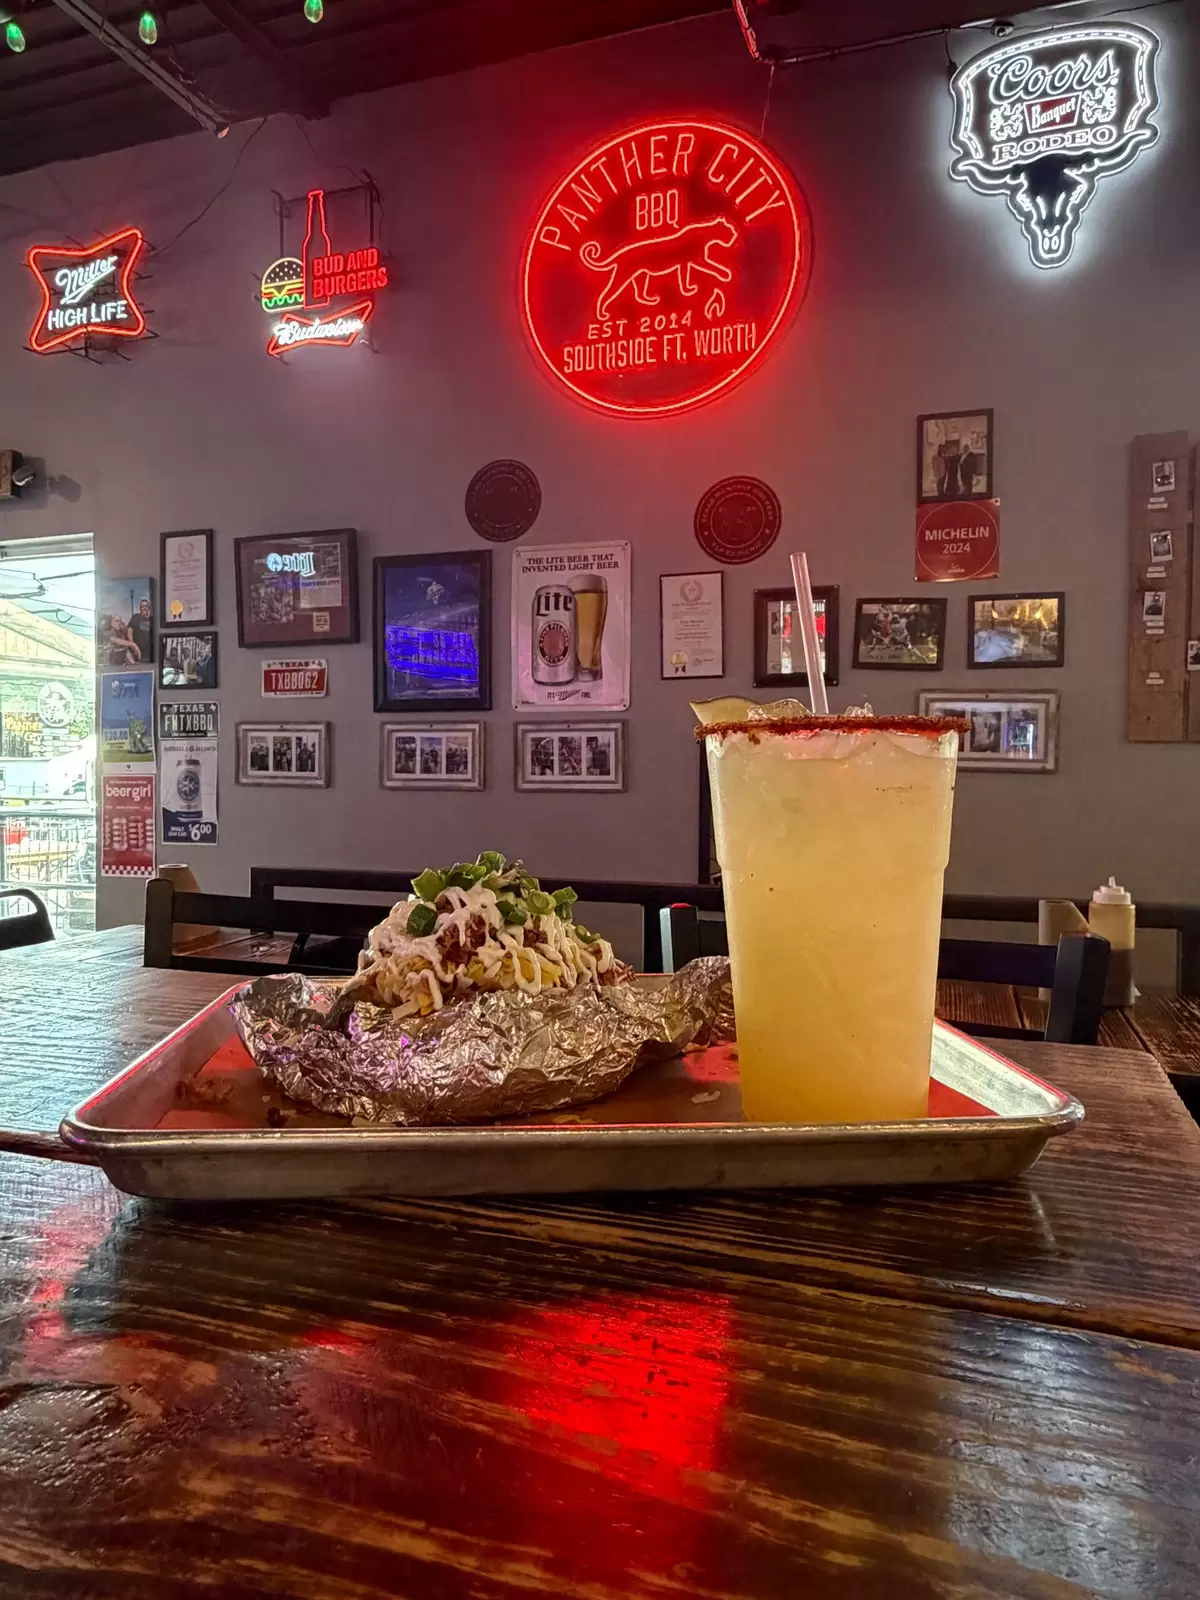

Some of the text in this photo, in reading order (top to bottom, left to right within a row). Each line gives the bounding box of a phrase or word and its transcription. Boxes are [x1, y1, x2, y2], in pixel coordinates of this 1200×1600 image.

[988, 49, 1120, 105] Coors
[1031, 97, 1076, 129] Banquet
[992, 125, 1117, 165] RODEO
[540, 133, 785, 250] PANTHER CITY
[636, 189, 679, 230] BBQ
[313, 248, 378, 276] BUD AND
[55, 255, 118, 304] Miller
[313, 267, 388, 298] BURGERS
[47, 300, 128, 330] HIGH LIFE
[588, 310, 692, 340] EST 2014
[273, 318, 364, 345] Budweiser
[563, 322, 756, 373] SOUTHSIDE FT. WORTH
[925, 526, 989, 541] MICHELIN
[942, 542, 971, 554] 2024
[522, 561, 619, 573] INVENTED LIGHT BEER
[546, 556, 566, 565] LITE
[567, 554, 589, 563] BEER
[592, 553, 615, 562] THAT
[536, 592, 573, 617] Lite
[271, 672, 318, 690] TXBBQ62
[173, 704, 205, 713] TEXAS
[106, 784, 151, 802] beergirl
